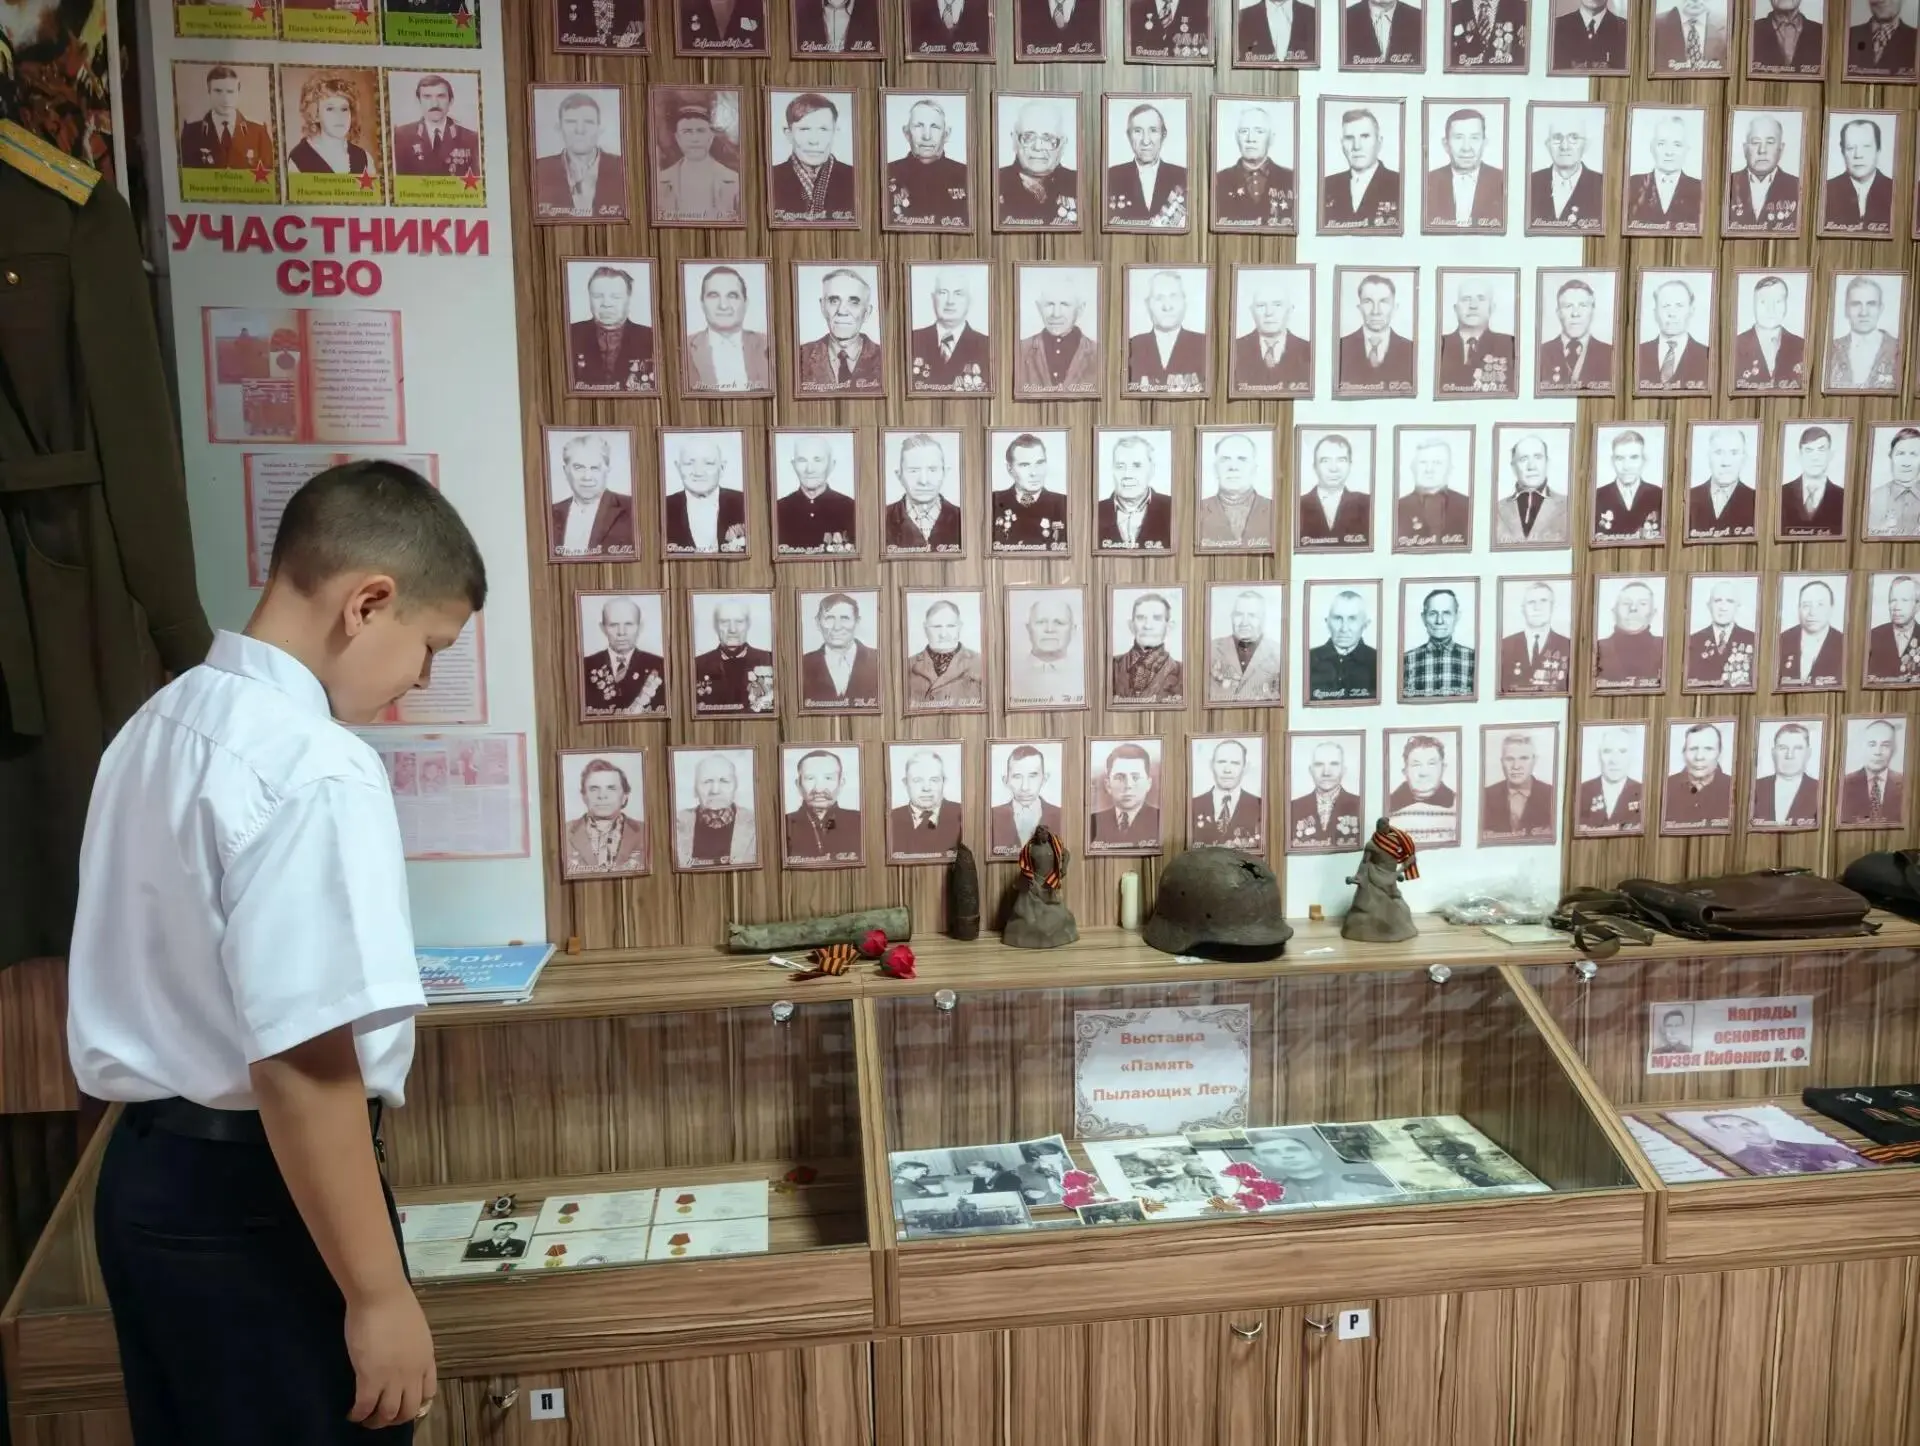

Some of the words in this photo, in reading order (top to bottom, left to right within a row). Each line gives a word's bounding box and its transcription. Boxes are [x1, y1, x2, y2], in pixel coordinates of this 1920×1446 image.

[167, 213, 490, 257] УЧАСТНИКИ
[276, 258, 383, 298] СВО
[1727, 1005, 1797, 1023] Награды
[1120, 1031, 1206, 1045] Выставка
[1713, 1027, 1806, 1045] основателя
[1120, 1058, 1195, 1073] «Память
[1651, 1052, 1701, 1069] музея
[1092, 1085, 1192, 1102] Пылающих
[1196, 1083, 1239, 1097] Лет»
[1349, 1313, 1360, 1330] Р
[541, 1393, 552, 1411] П
